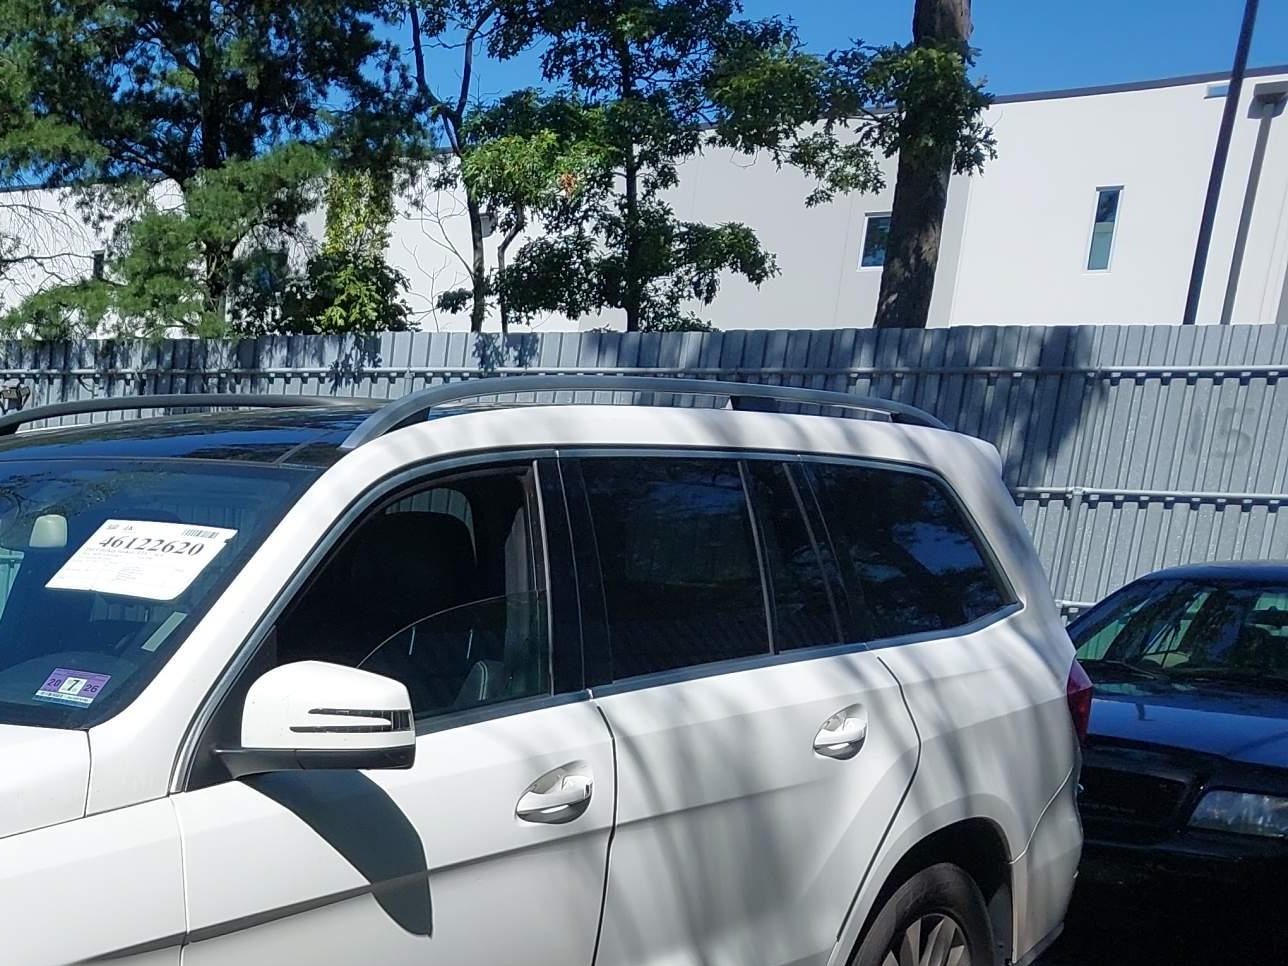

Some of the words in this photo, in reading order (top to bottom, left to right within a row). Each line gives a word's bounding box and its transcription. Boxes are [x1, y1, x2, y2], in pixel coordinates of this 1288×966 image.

[99, 535, 205, 556] 46122620
[47, 678, 62, 687] 20
[67, 680, 80, 691] 7
[83, 684, 100, 693] 26
